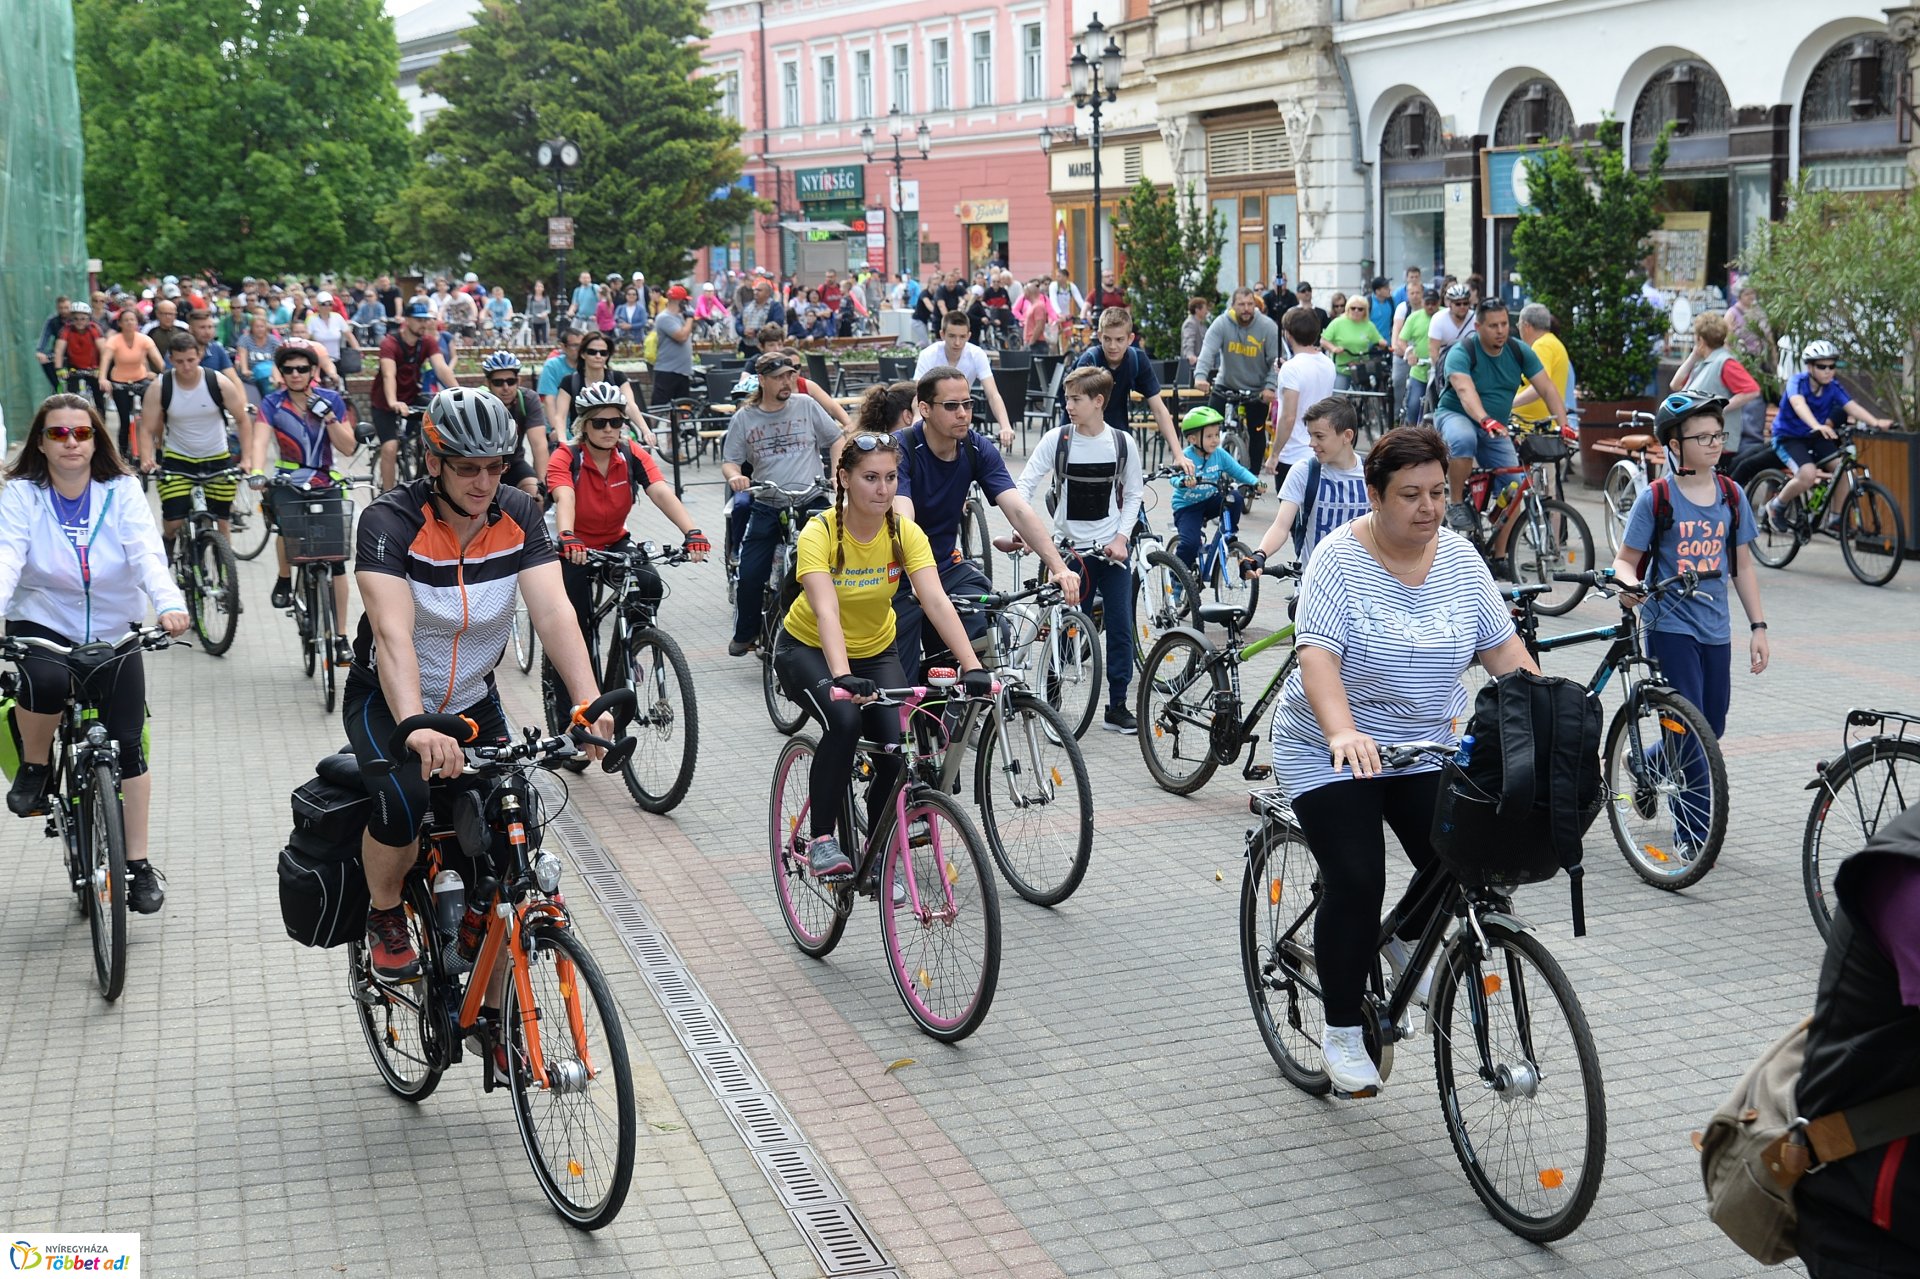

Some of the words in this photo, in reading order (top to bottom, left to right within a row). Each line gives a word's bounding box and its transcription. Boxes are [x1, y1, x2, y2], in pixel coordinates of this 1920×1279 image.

[801, 168, 855, 192] NYÍRSÉG
[1679, 520, 1712, 538] IT'S
[1715, 521, 1725, 537] A
[1677, 540, 1722, 557] GOOD
[845, 565, 874, 575] bedste
[876, 566, 886, 574] er
[1677, 557, 1721, 575] DAY
[844, 578, 856, 586] for
